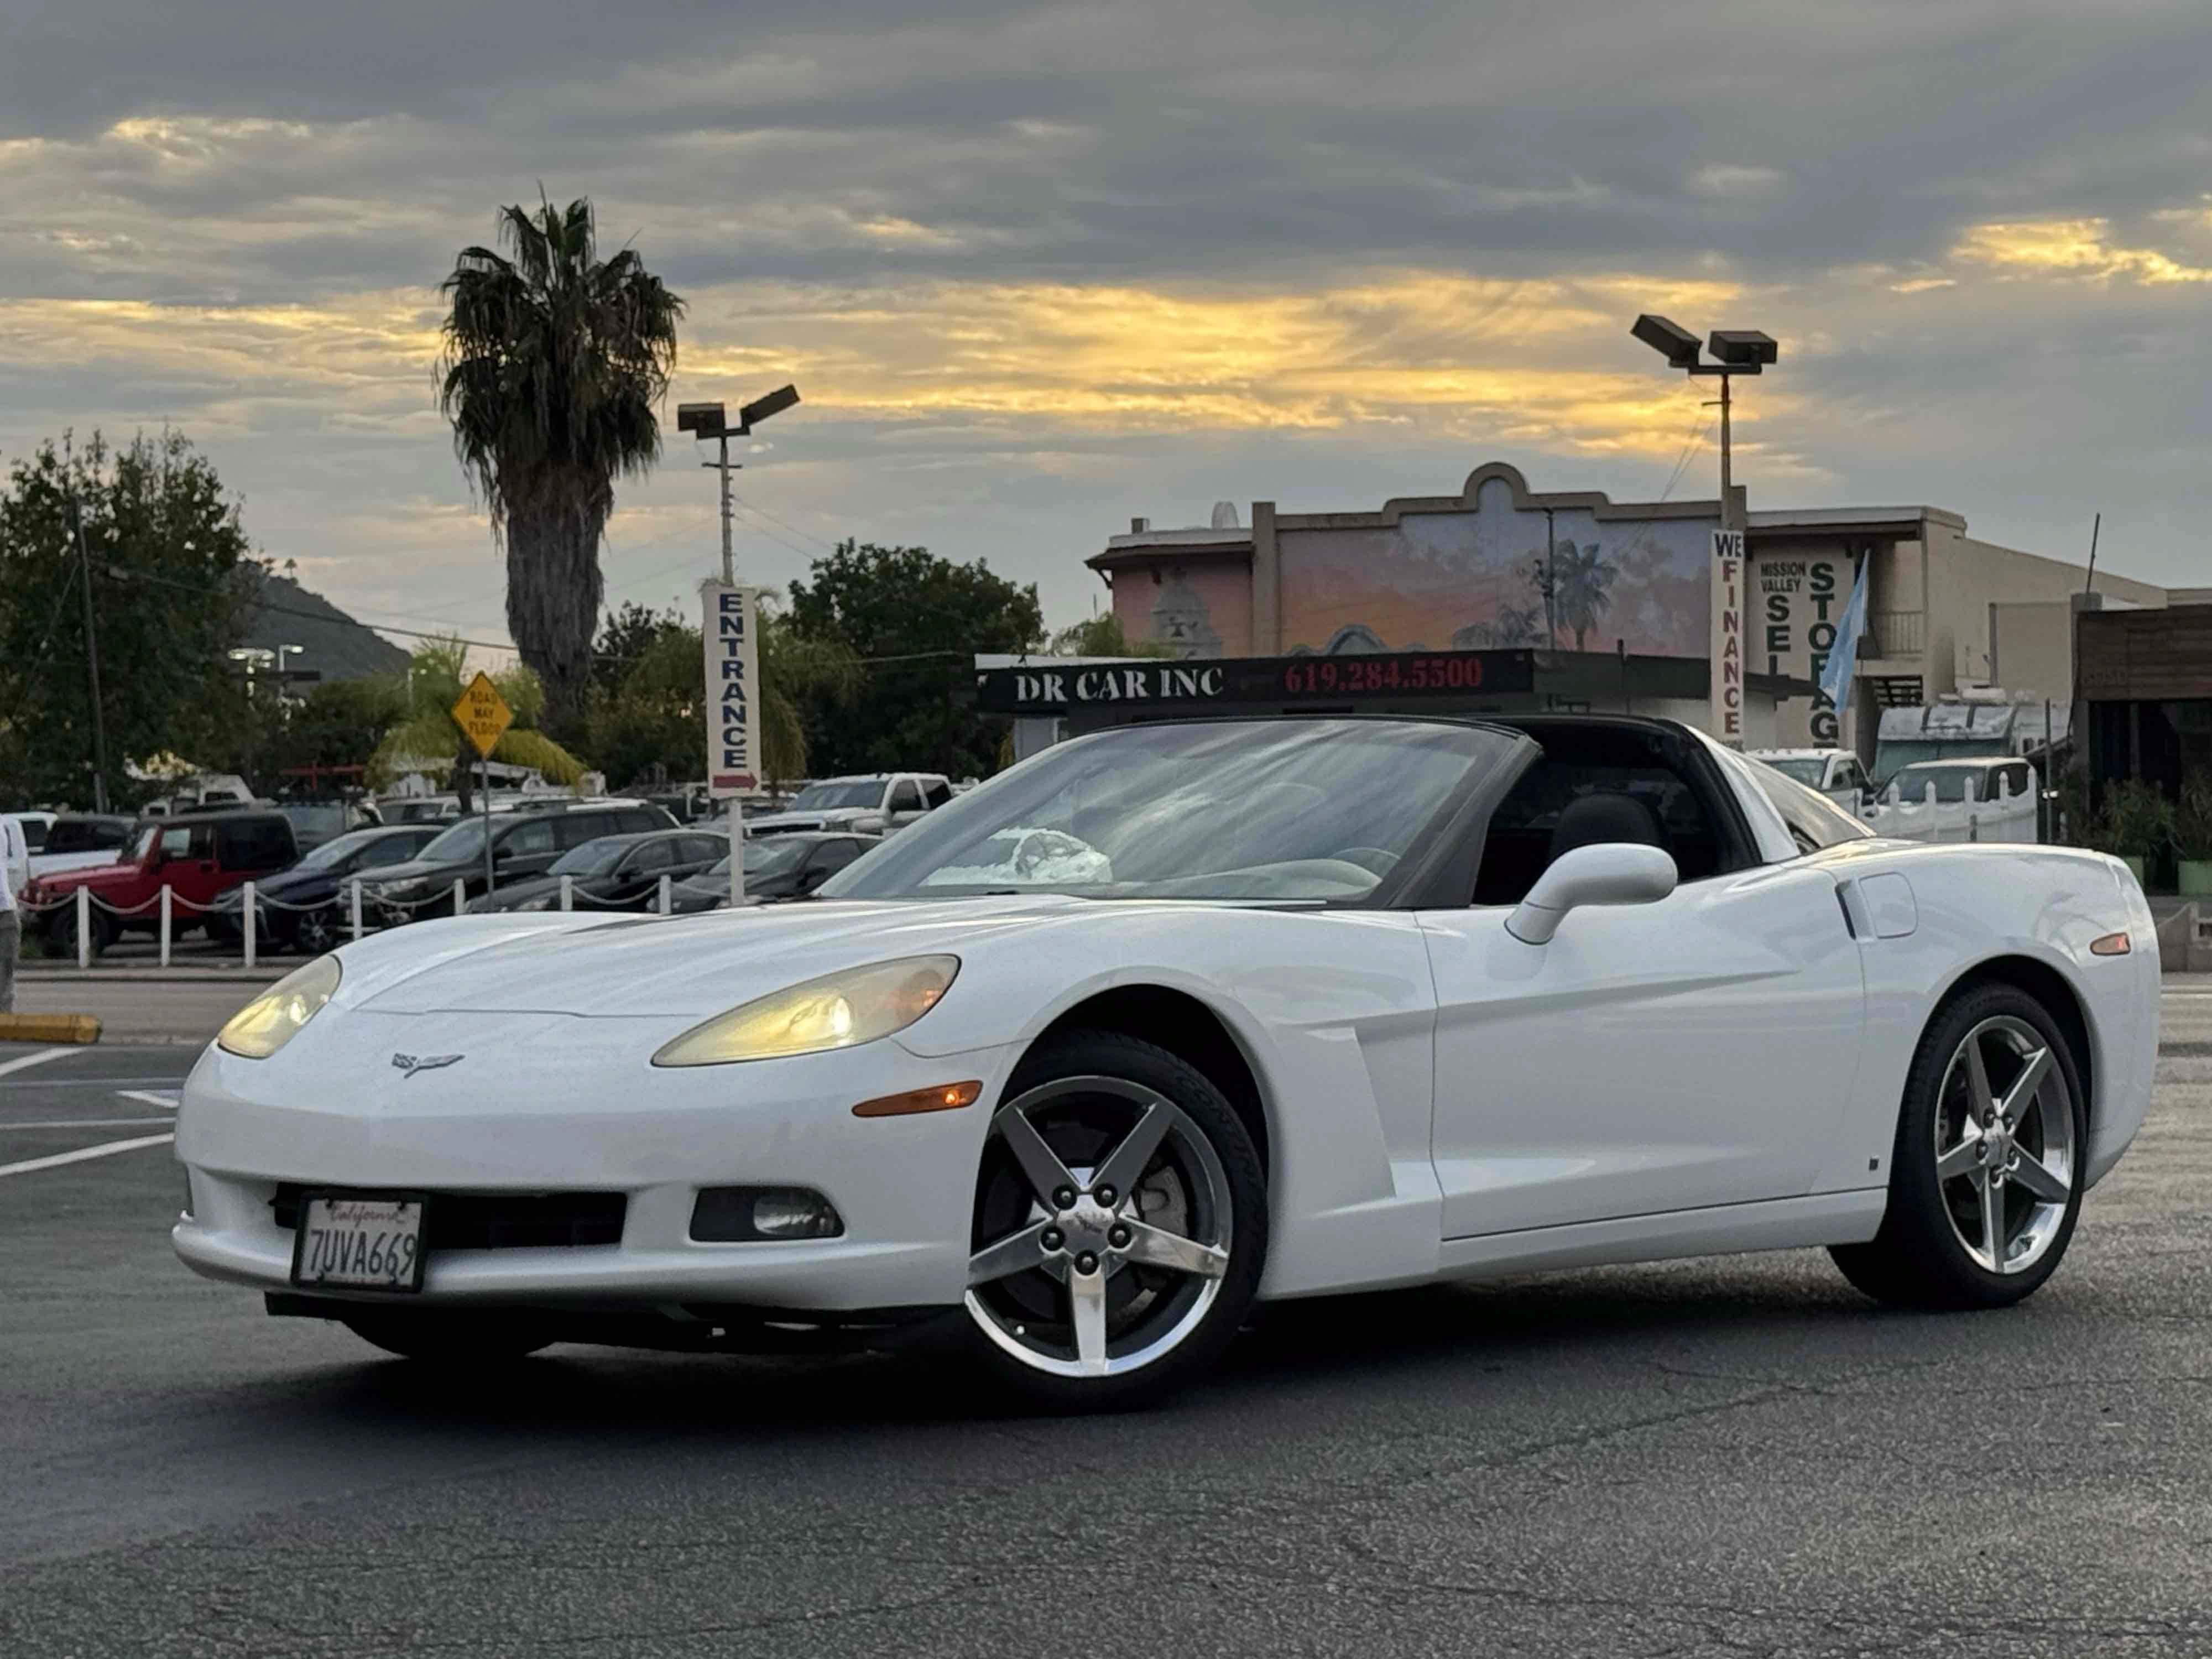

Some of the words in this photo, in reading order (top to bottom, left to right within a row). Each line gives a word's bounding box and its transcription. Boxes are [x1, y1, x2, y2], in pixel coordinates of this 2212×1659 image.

[1714, 533, 1742, 558] WE
[1761, 562, 1806, 577] MISSION
[1761, 579, 1801, 593] VALLEY
[1722, 560, 1740, 734] FINANCE
[719, 593, 747, 769] ENTRANCE
[1015, 672, 1068, 702] DR
[1076, 669, 1150, 701] CAR
[1160, 667, 1223, 698] INC
[1284, 658, 1484, 692] 619.284.5500
[474, 707, 494, 719] MAY
[310, 1229, 416, 1277] 7UVA669
